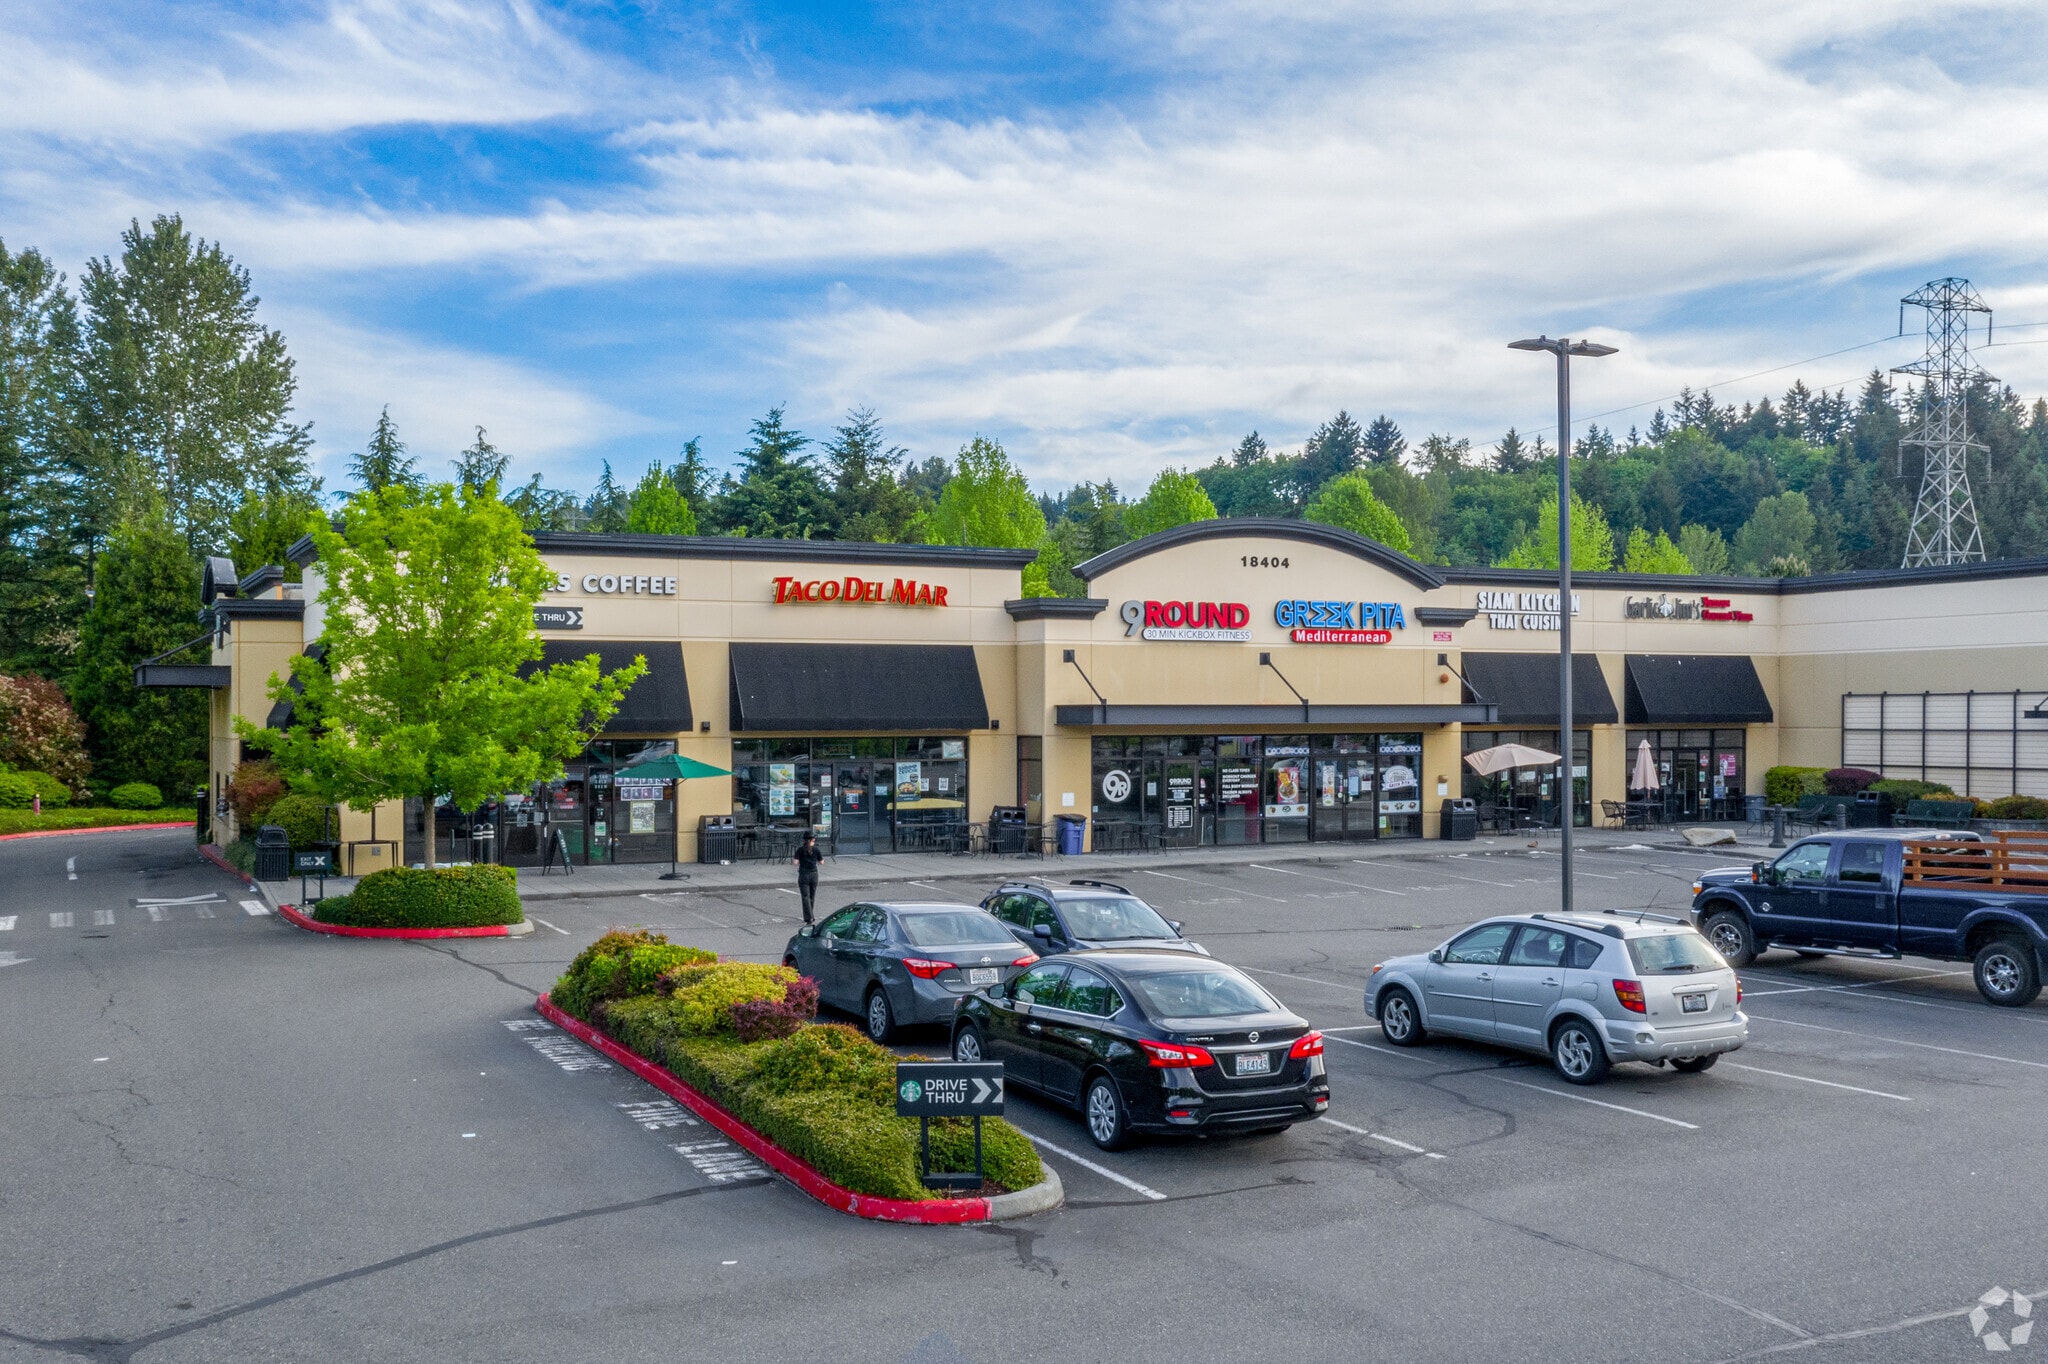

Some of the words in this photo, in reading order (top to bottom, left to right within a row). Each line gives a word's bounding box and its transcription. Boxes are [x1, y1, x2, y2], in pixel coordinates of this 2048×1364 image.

[1241, 556, 1290, 569] 18404
[582, 573, 678, 595] COFFEE
[772, 577, 840, 604] TACO
[842, 576, 886, 603] DEL
[890, 578, 948, 607] MAR
[1477, 591, 1515, 610] SIAM
[1519, 593, 1580, 612] KITCHN
[1623, 596, 1660, 619] Garlic
[541, 613, 566, 622] THRU
[1120, 599, 1250, 637] 9ROUND
[1361, 602, 1406, 629] PITA
[1489, 613, 1518, 629] THAI
[1521, 614, 1561, 630] CUISIN
[1147, 630, 1157, 638] 30
[1159, 630, 1176, 638] MIN
[1178, 630, 1215, 639] KICKBOX
[1217, 631, 1250, 639] FITNESS
[1295, 630, 1387, 643] Mediterranean
[925, 1079, 968, 1091] DRIVE
[925, 1091, 965, 1103] THRU
